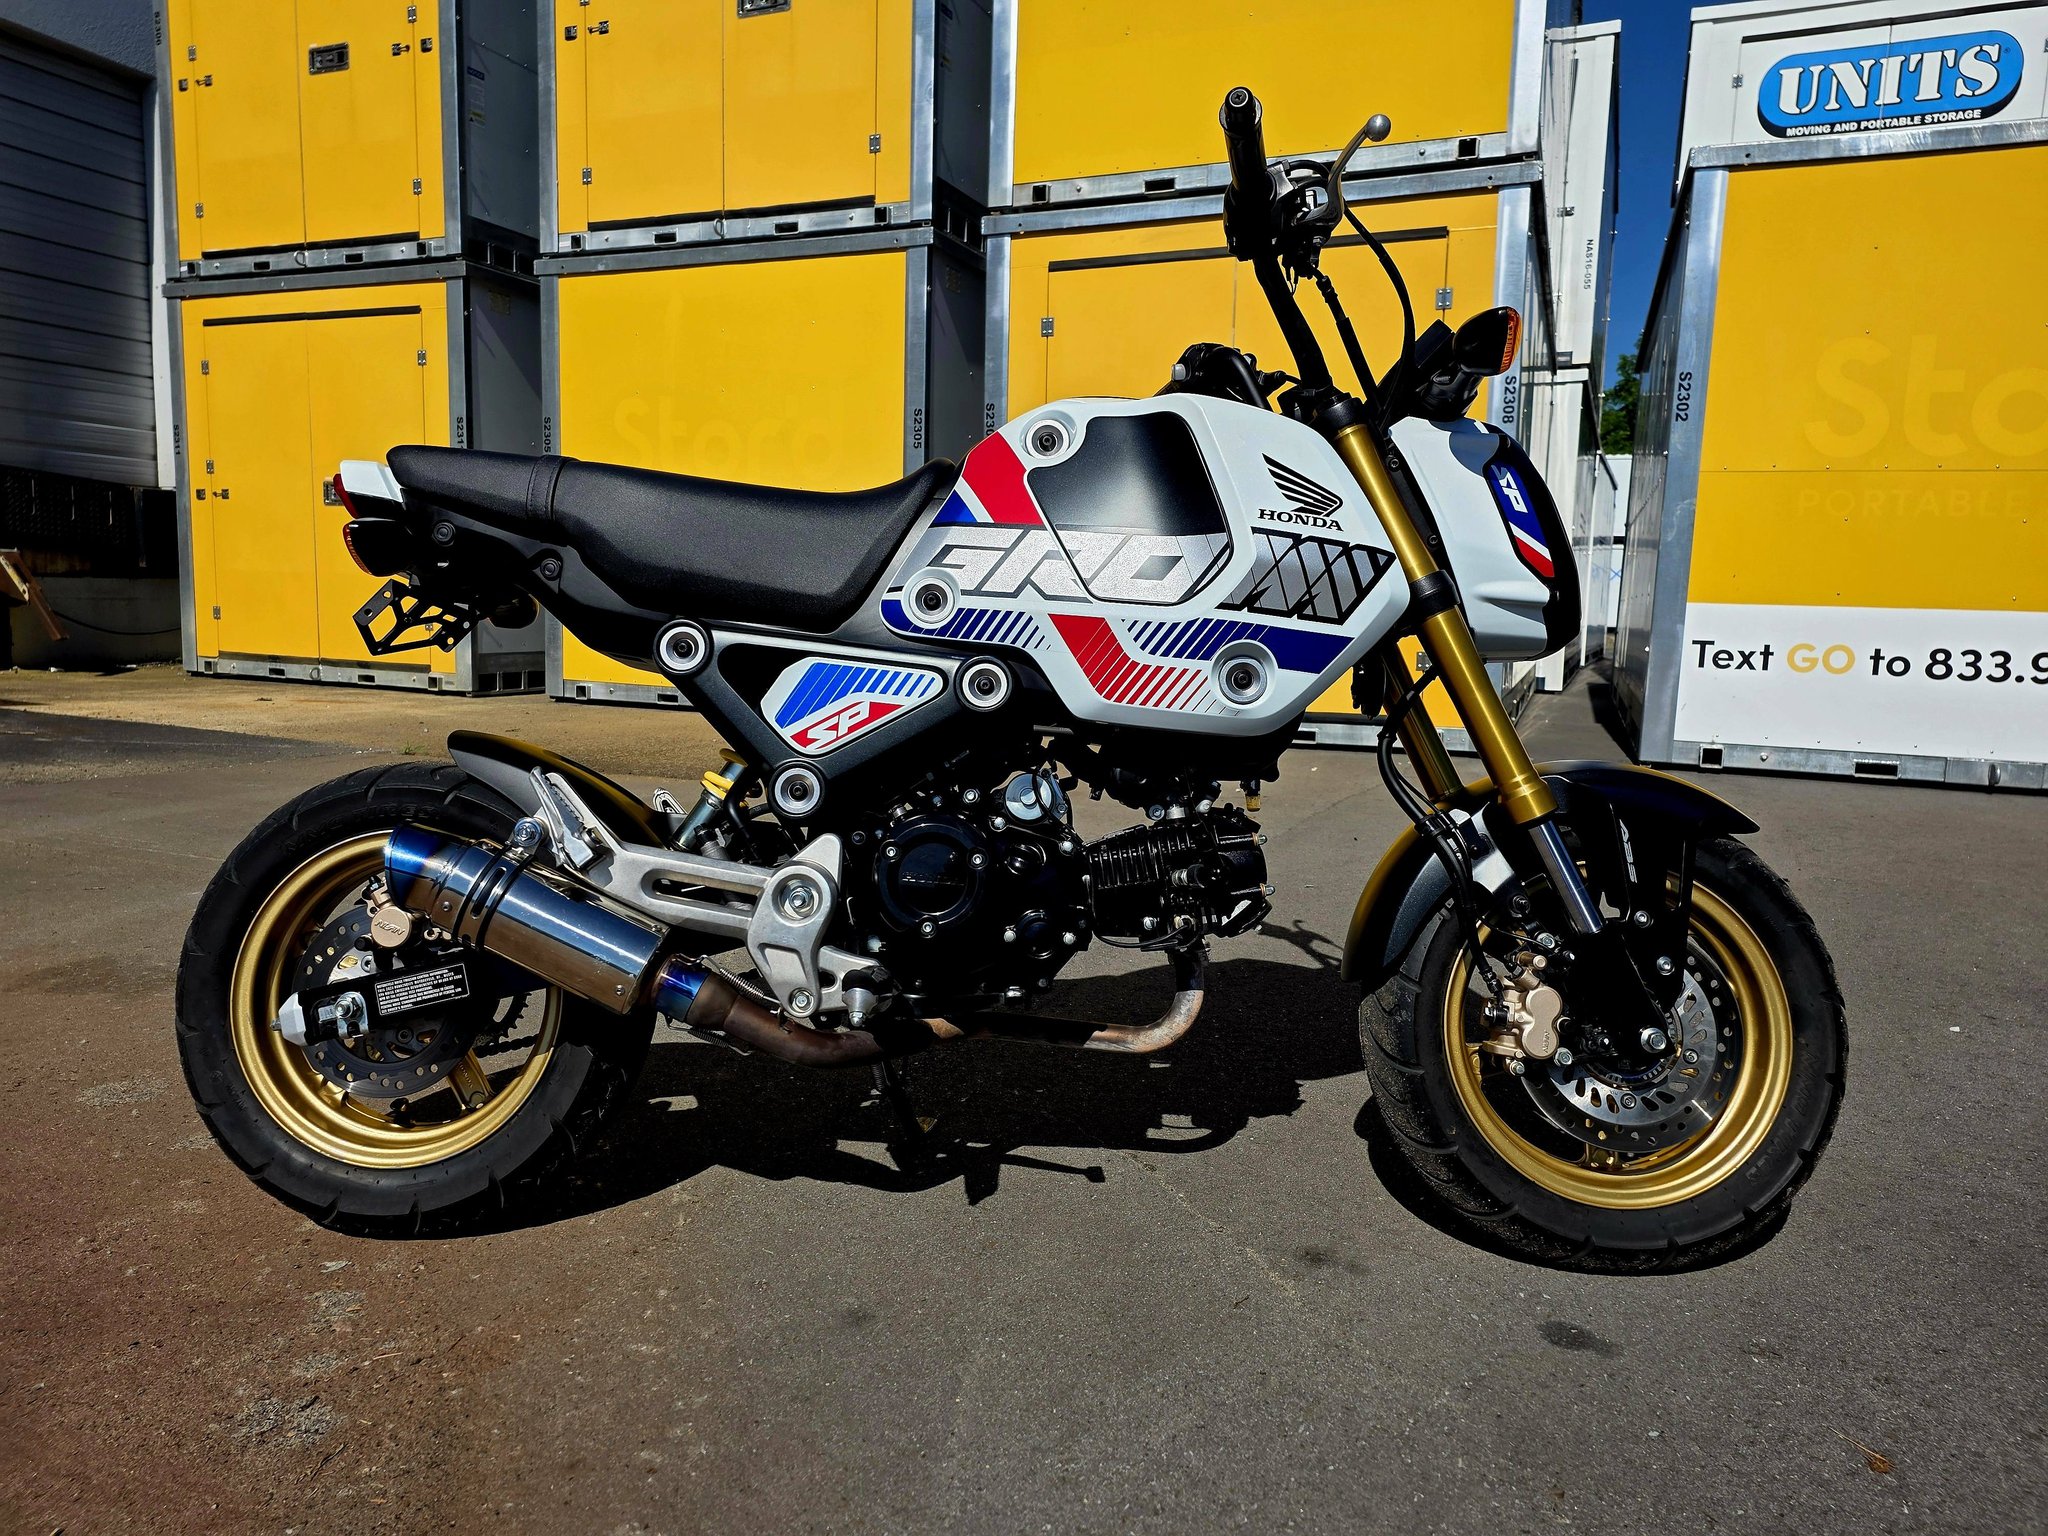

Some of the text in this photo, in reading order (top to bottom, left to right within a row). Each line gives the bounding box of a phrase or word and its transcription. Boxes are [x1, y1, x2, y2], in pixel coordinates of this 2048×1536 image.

[1778, 43, 2001, 115] UNITS
[1786, 109, 1982, 137] MOVING AND PORTABLE STORAGE
[1502, 375, 1517, 424] S2308
[1675, 371, 1693, 422] S2302
[543, 416, 552, 453] S2305
[913, 408, 923, 449] S2305
[1491, 464, 1529, 513] SP
[1257, 508, 1344, 532] HONDA
[1692, 639, 1774, 671] Text
[1786, 643, 1856, 675] GO
[1869, 648, 1911, 677] to
[804, 700, 870, 750] SP
[1618, 818, 1638, 884] ABS
